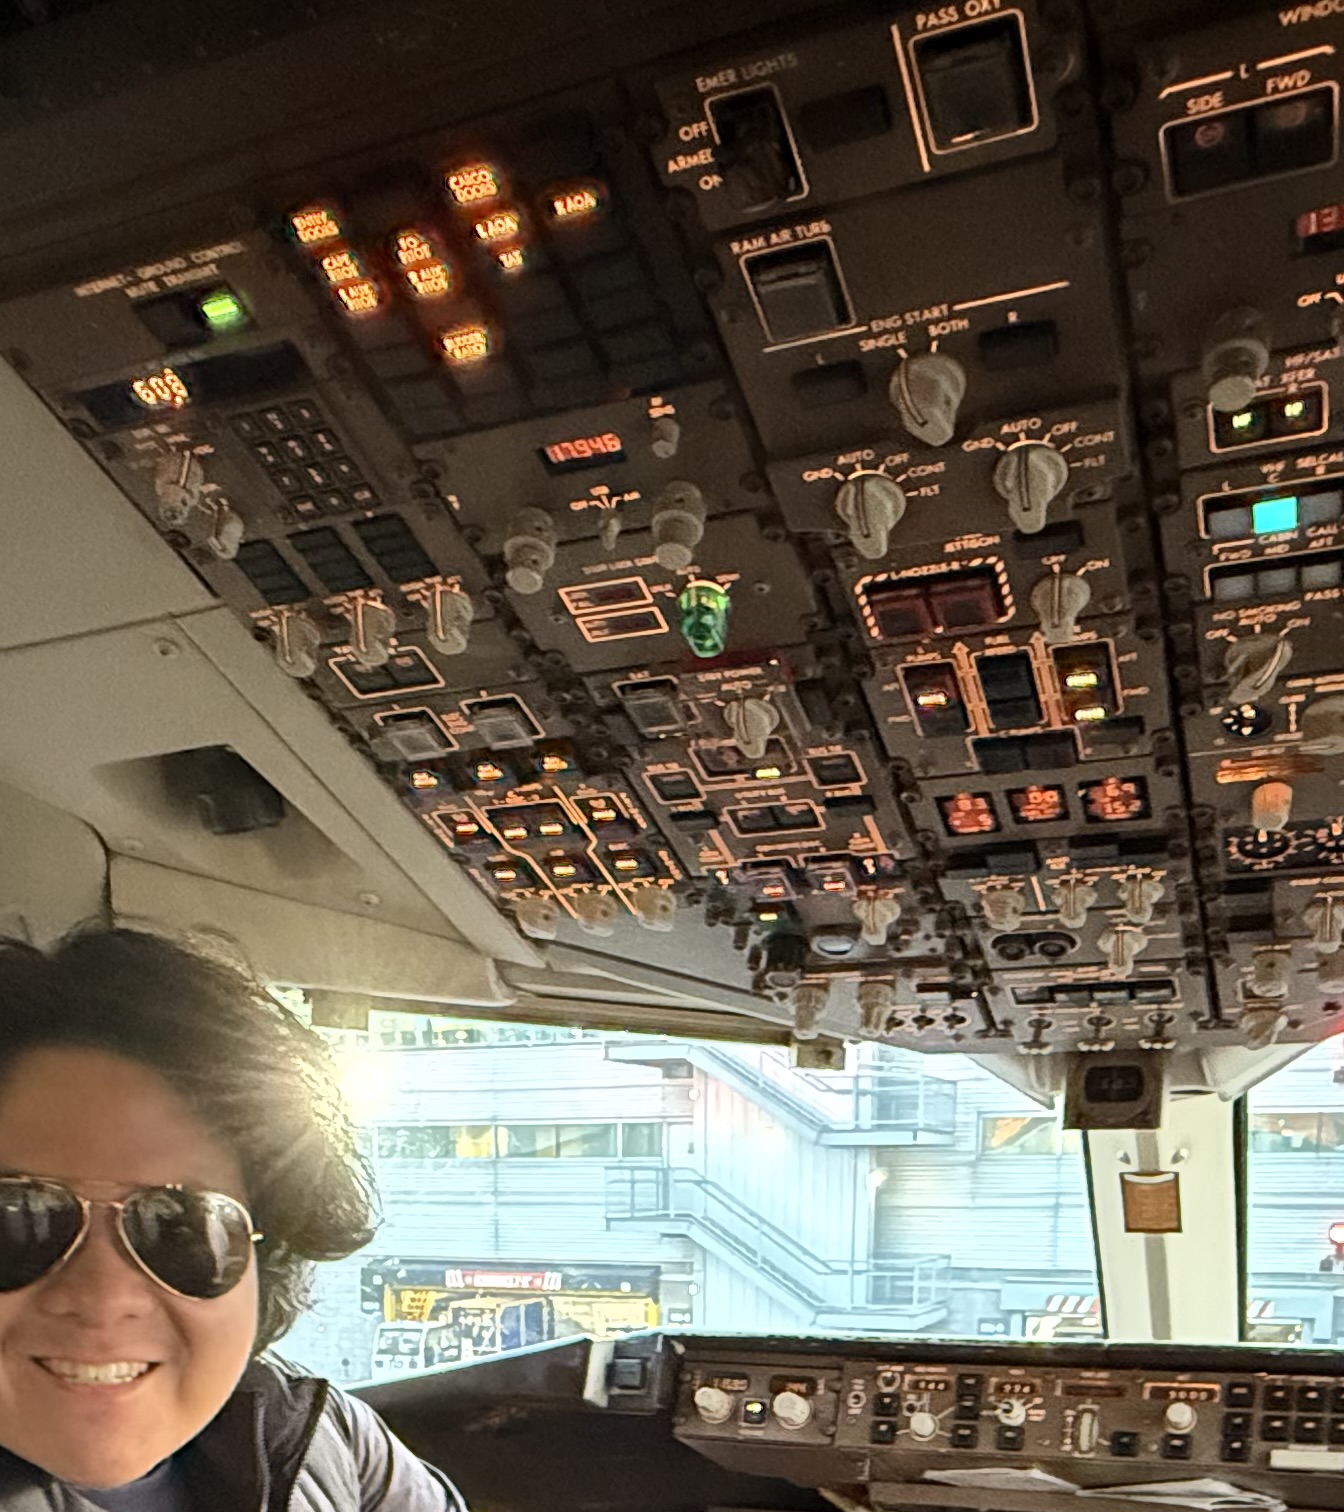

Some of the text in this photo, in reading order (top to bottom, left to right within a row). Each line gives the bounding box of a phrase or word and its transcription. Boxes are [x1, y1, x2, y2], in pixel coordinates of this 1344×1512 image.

[915, 6, 958, 31] PASS
[695, 53, 798, 93] EMER LIGHTS
[1265, 69, 1311, 95] FWD
[1185, 91, 1224, 115] SIDE
[678, 121, 709, 141] OFF
[565, 192, 598, 214] AOA
[486, 214, 520, 237] AOA
[729, 233, 768, 256] RAM
[870, 303, 950, 332] ENG START
[928, 318, 970, 337] BOTH
[859, 331, 907, 352] SINGLE
[1000, 416, 1043, 435] AUTO
[1050, 420, 1079, 437] OFF
[1074, 430, 1115, 449] CONT
[836, 449, 875, 466] AUTO
[1306, 523, 1339, 538] CALL
